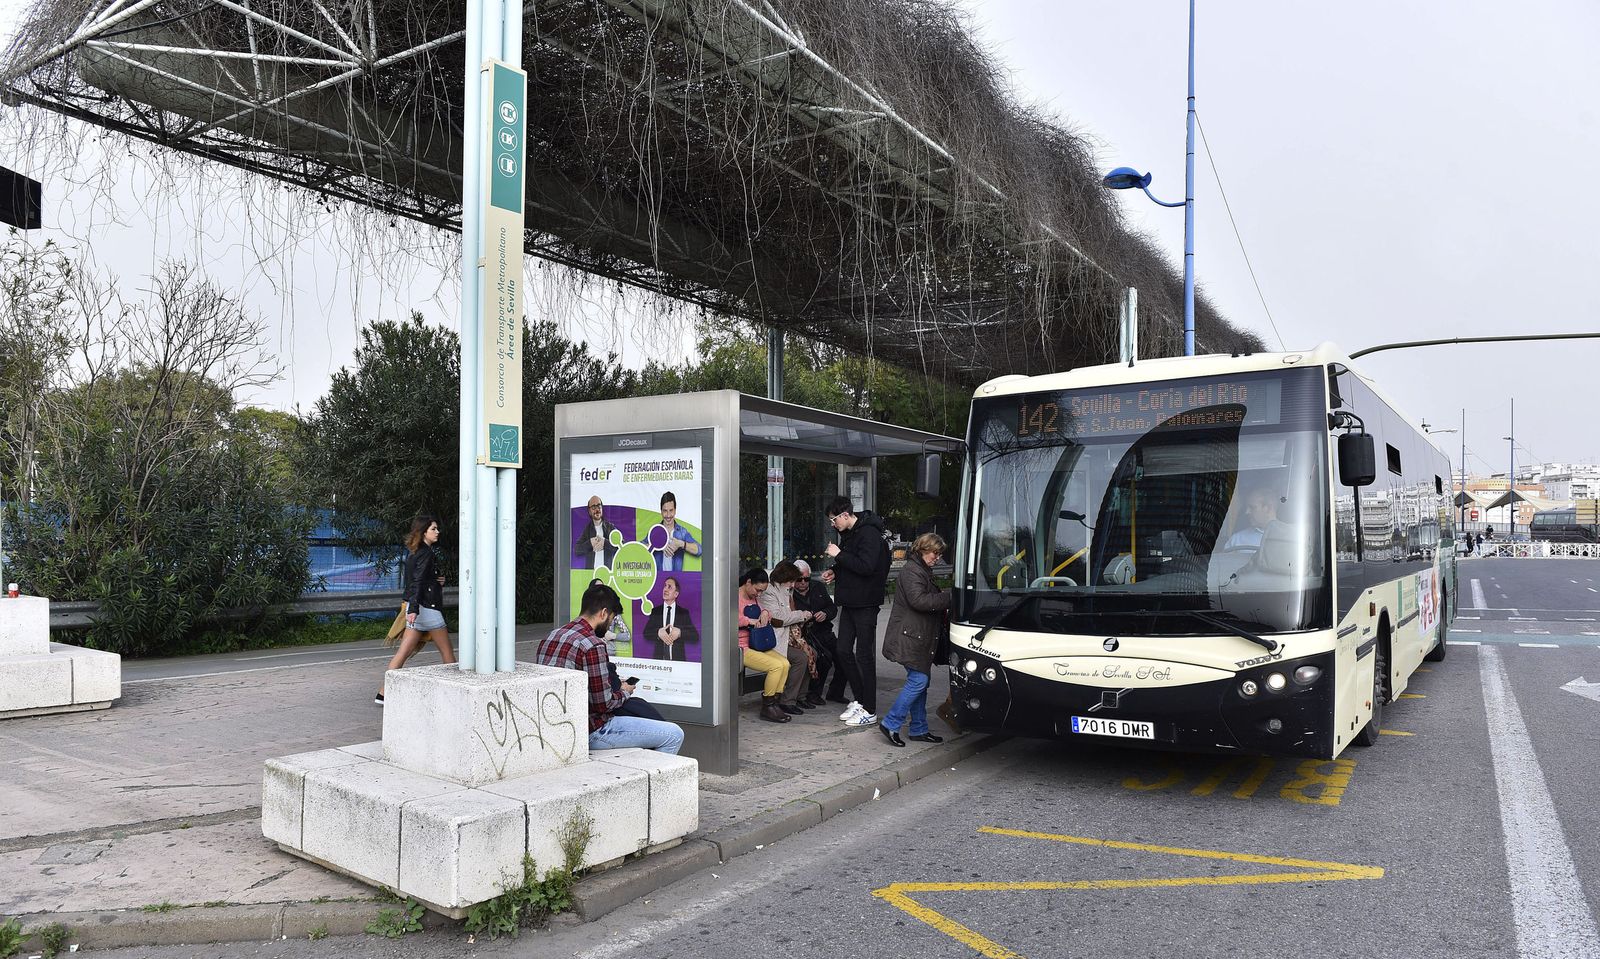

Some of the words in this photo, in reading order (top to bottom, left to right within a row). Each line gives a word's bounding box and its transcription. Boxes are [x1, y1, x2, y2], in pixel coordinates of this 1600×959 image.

[497, 227, 507, 293] Metropolitano
[507, 280, 515, 315] Sevilla
[497, 296, 507, 346] Transporte
[507, 318, 515, 331] de
[497, 348, 505, 360] de
[505, 334, 515, 360] Área
[496, 363, 505, 408] Consorcio
[1072, 394, 1120, 416] Sevilla
[1138, 388, 1183, 411] Coria
[1189, 384, 1213, 408] del
[1019, 402, 1059, 435] 142
[1157, 410, 1242, 428] Palomares
[618, 439, 647, 447] JCDecaux
[624, 460, 660, 473] FEDERACIÓN
[661, 459, 693, 472] ESPAÑOLA
[580, 467, 612, 482] feder
[623, 473, 630, 483] DE
[631, 472, 673, 482] ENFERMEDADES
[674, 471, 694, 481] RARAS
[967, 643, 1001, 659] Castrosua
[615, 661, 673, 672] nfermedades-raras.org
[1234, 654, 1283, 668] VOLVO
[1102, 664, 1132, 678] Sevilla
[1081, 719, 1117, 734] 7016
[1122, 722, 1150, 738] DMR
